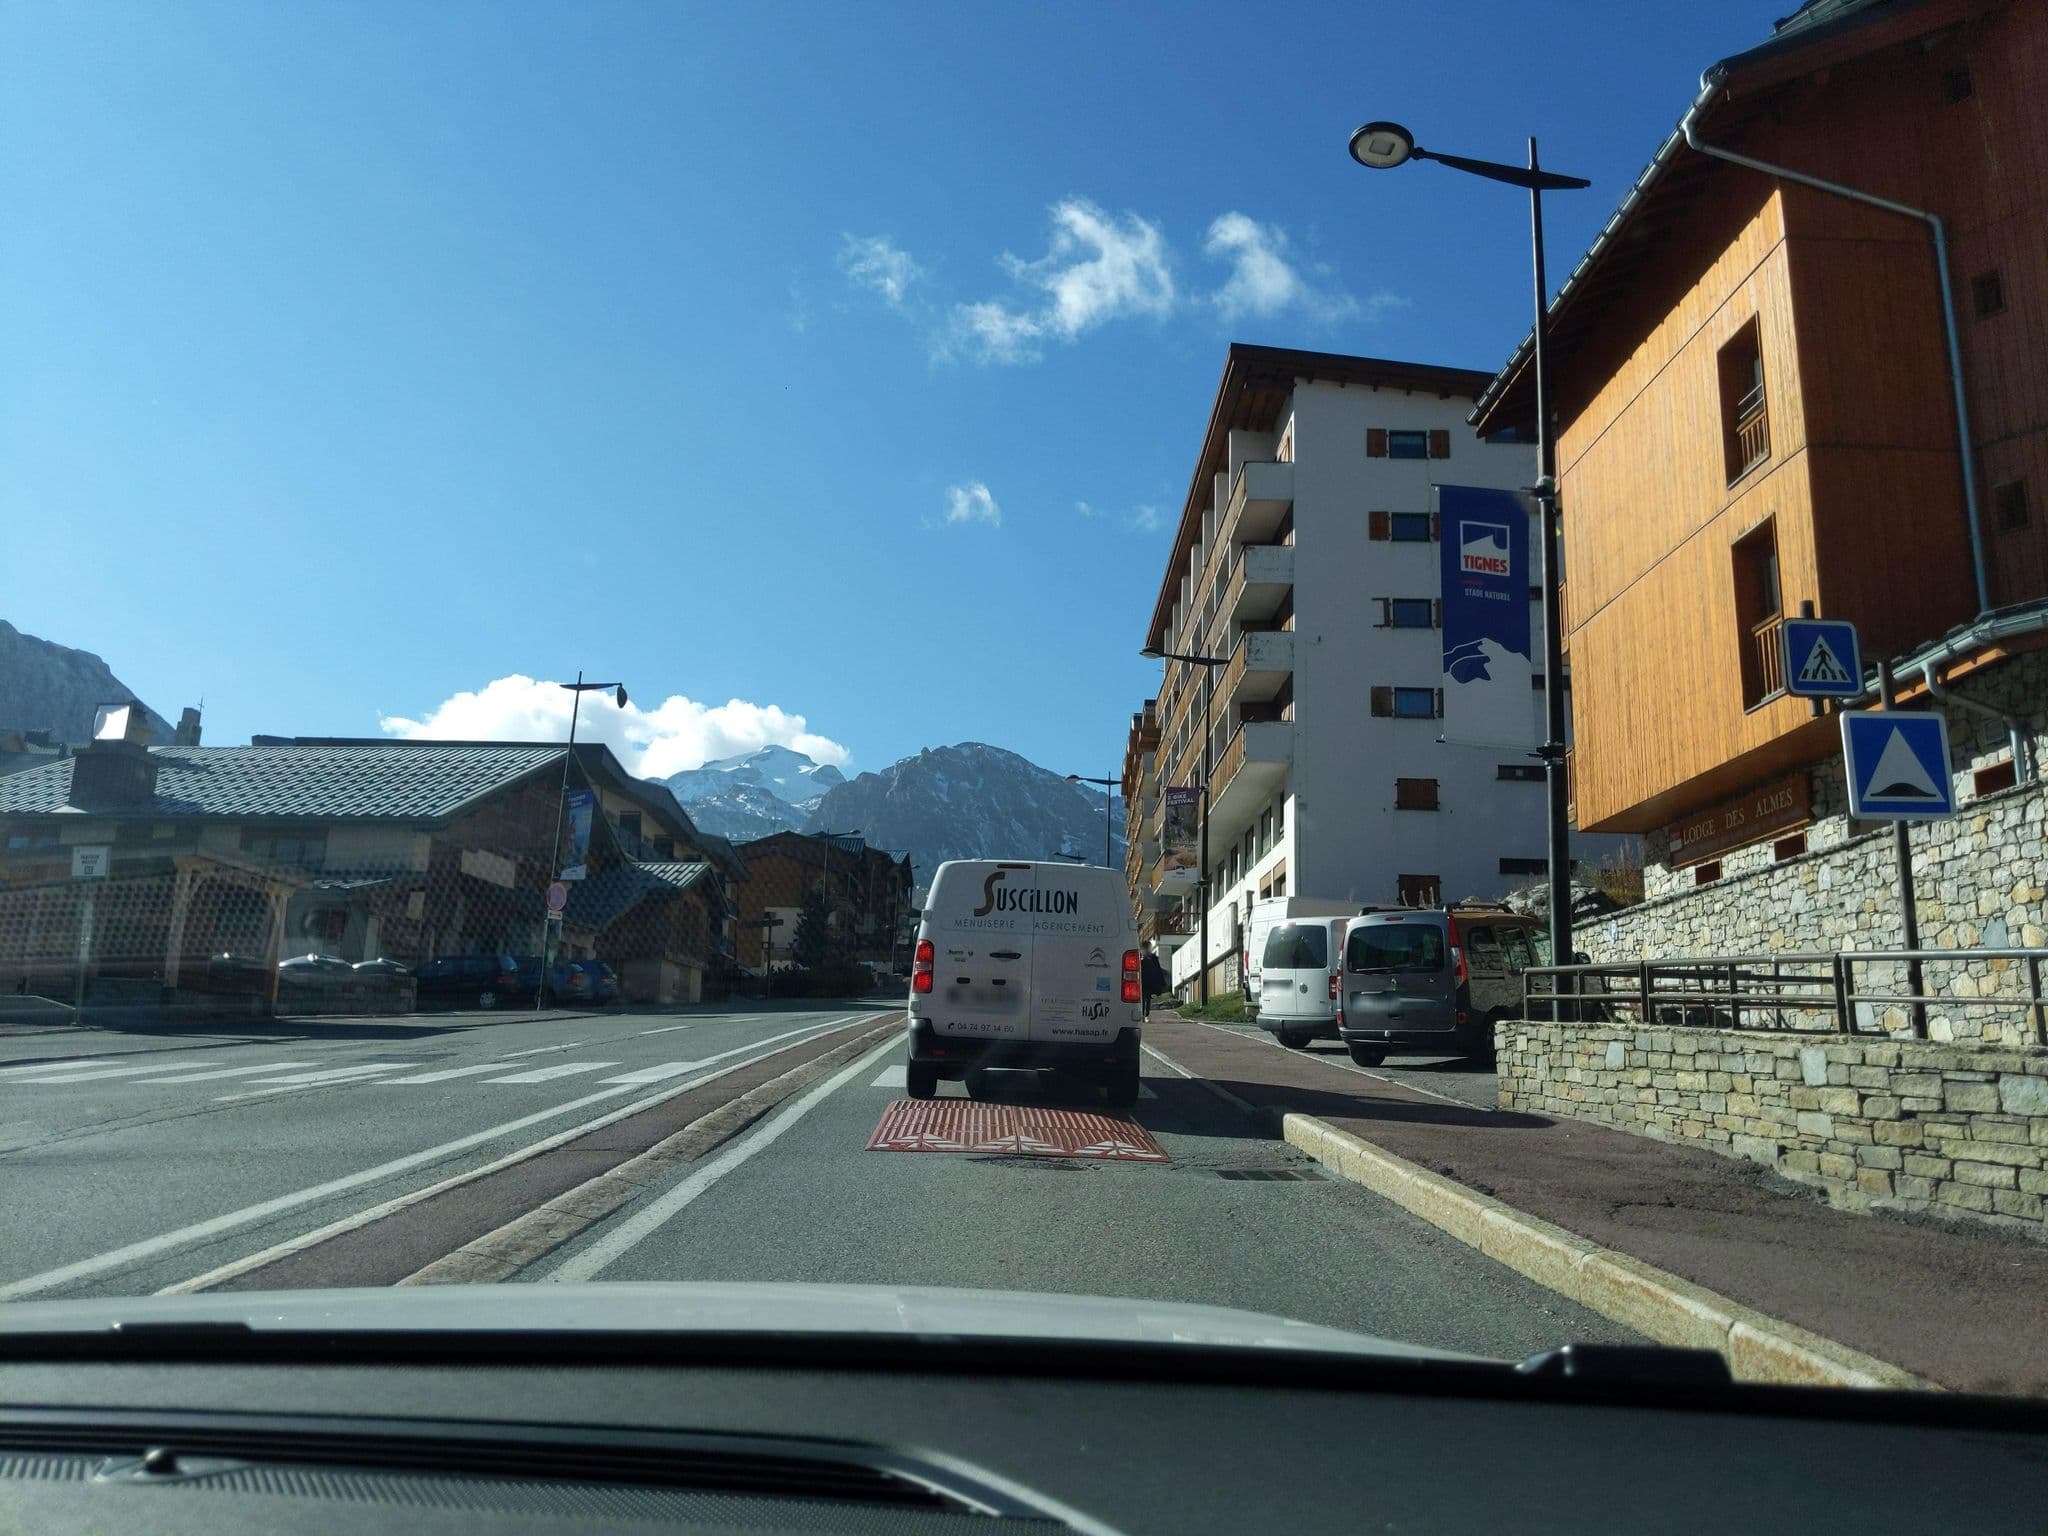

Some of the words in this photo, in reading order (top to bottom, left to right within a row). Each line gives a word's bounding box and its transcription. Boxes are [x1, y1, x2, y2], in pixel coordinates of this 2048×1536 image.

[1463, 555, 1508, 573] TIGNES
[1464, 588, 1484, 598] STADE
[1484, 591, 1511, 601] NATUREL
[1683, 819, 1716, 845] LODGE
[1725, 808, 1745, 829] DES
[1756, 788, 1793, 818] ALMES
[1034, 922, 1105, 934] AGENCEMENT
[1082, 1003, 1110, 1020] HASAP
[1052, 1028, 1108, 1037] www.hasap.fr
